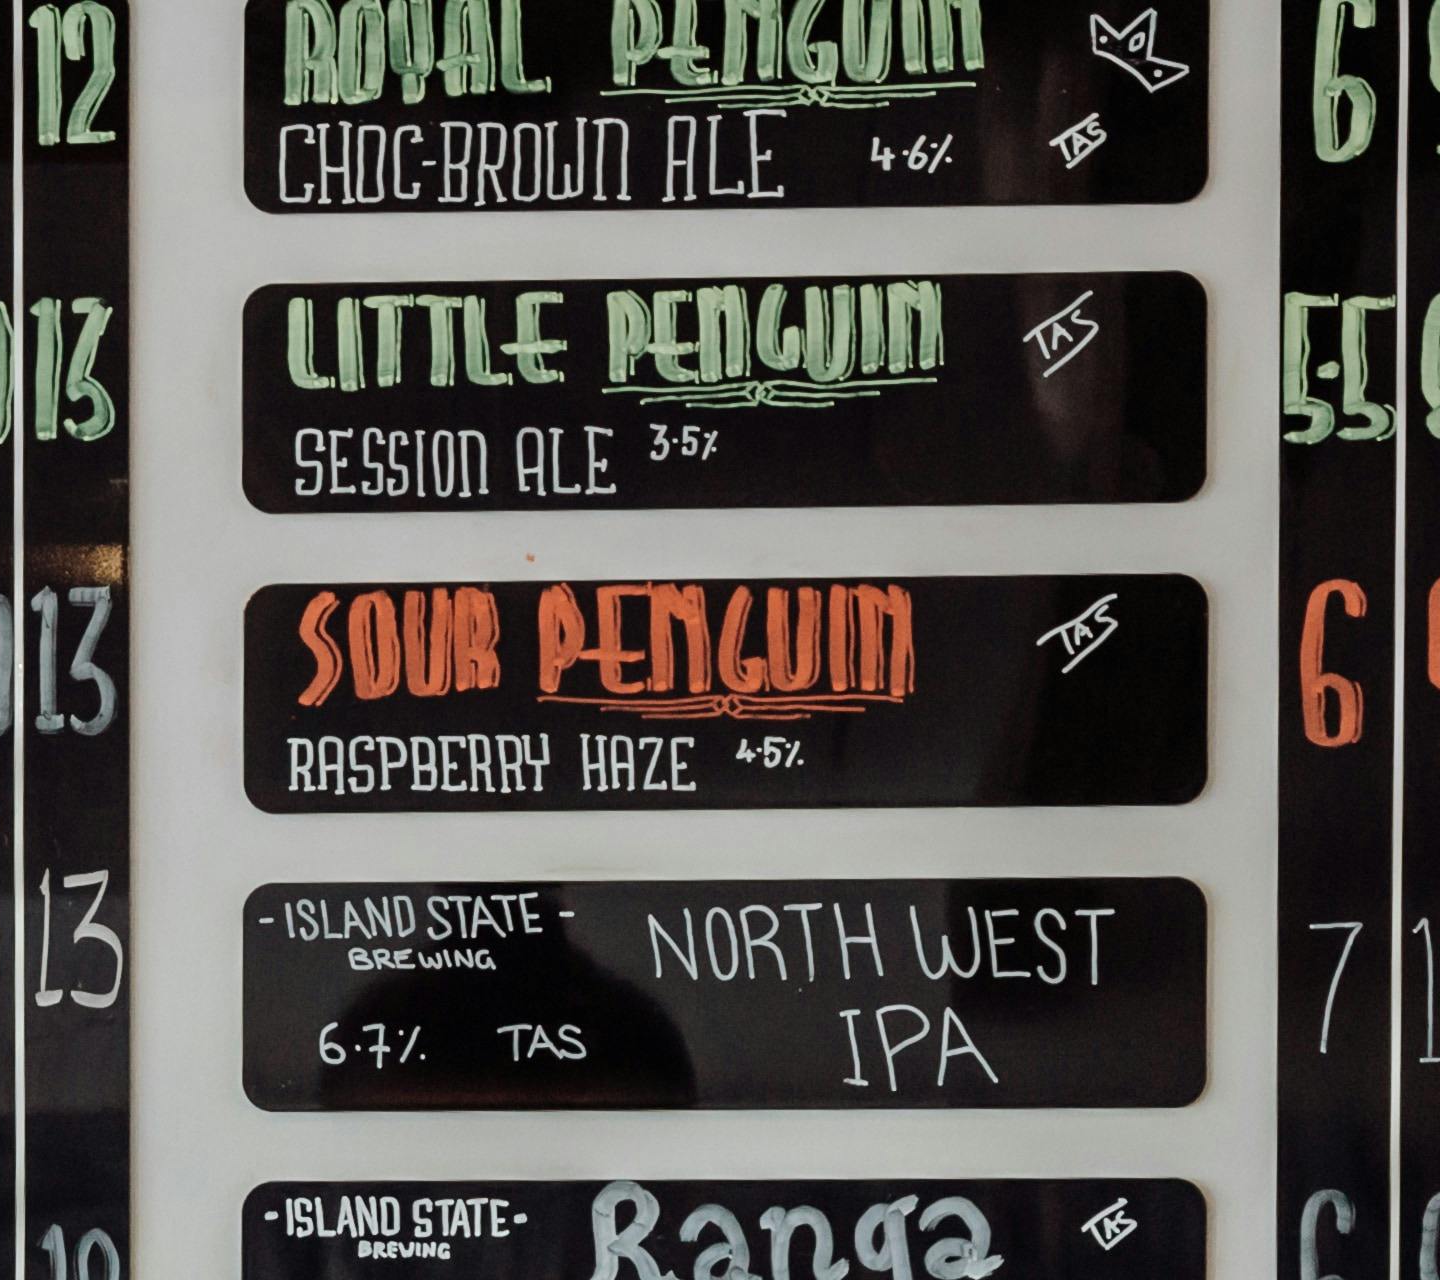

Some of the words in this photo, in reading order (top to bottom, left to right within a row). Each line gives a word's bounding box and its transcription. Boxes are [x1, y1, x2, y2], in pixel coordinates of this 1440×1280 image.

[29, 1, 117, 146] 12
[284, 0, 552, 106] ROYAL
[663, 109, 787, 201] ALE
[30, 297, 115, 441] 13
[287, 290, 568, 392] LITTLE
[606, 281, 945, 383] PENGUIN
[294, 426, 488, 498] SESSION
[517, 424, 617, 497] ALE
[298, 587, 499, 706] SOUR
[536, 583, 916, 694] PENGUIN
[1300, 578, 1367, 748] 6
[287, 735, 553, 795] RASPBERRY
[581, 735, 697, 793] HAZE
[348, 948, 497, 972] BREWING
[647, 904, 883, 982] NORTH
[917, 906, 1115, 988] WEST
[498, 1024, 587, 1061] TAS
[839, 1005, 999, 1090] IPA
